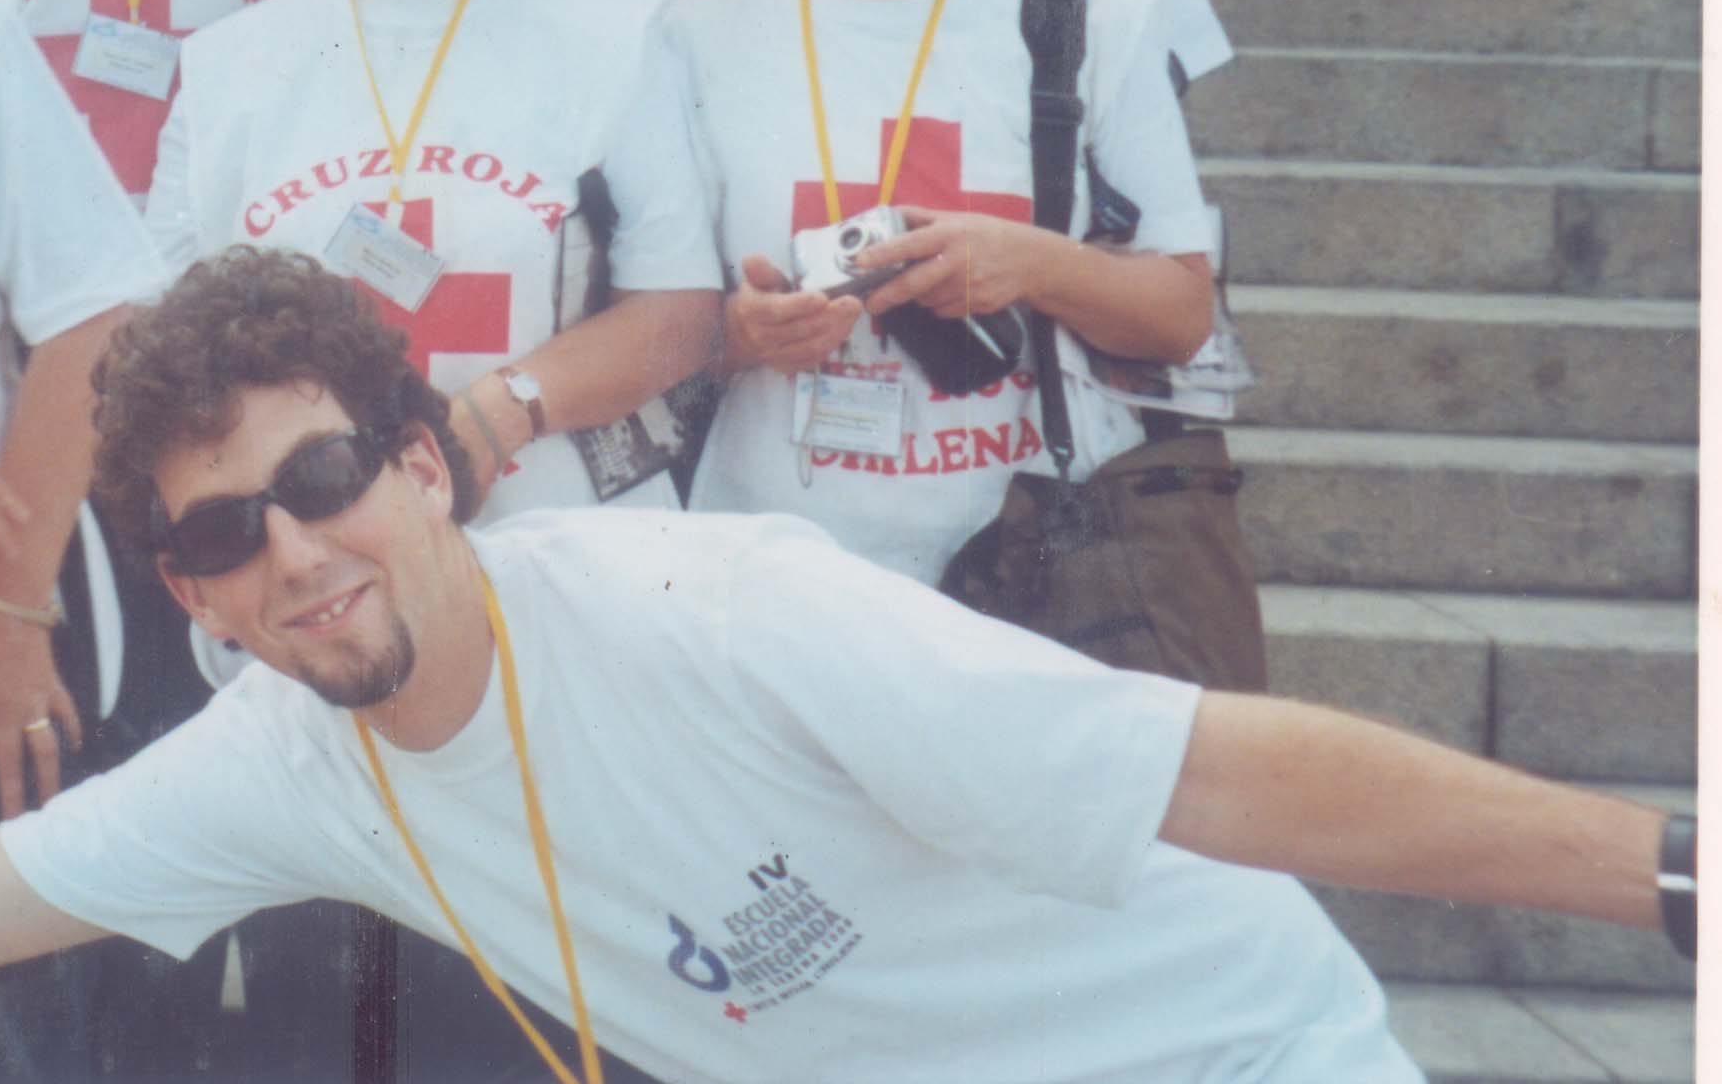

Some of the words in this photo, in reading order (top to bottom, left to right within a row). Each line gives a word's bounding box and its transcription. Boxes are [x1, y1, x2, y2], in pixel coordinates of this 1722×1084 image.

[244, 147, 392, 238] CRUZ
[416, 144, 568, 235] ROJA
[723, 875, 811, 937] ESCUELA
[746, 852, 789, 892] IV
[720, 891, 827, 966] NACIONAL
[731, 908, 841, 987] INTEGRADA
